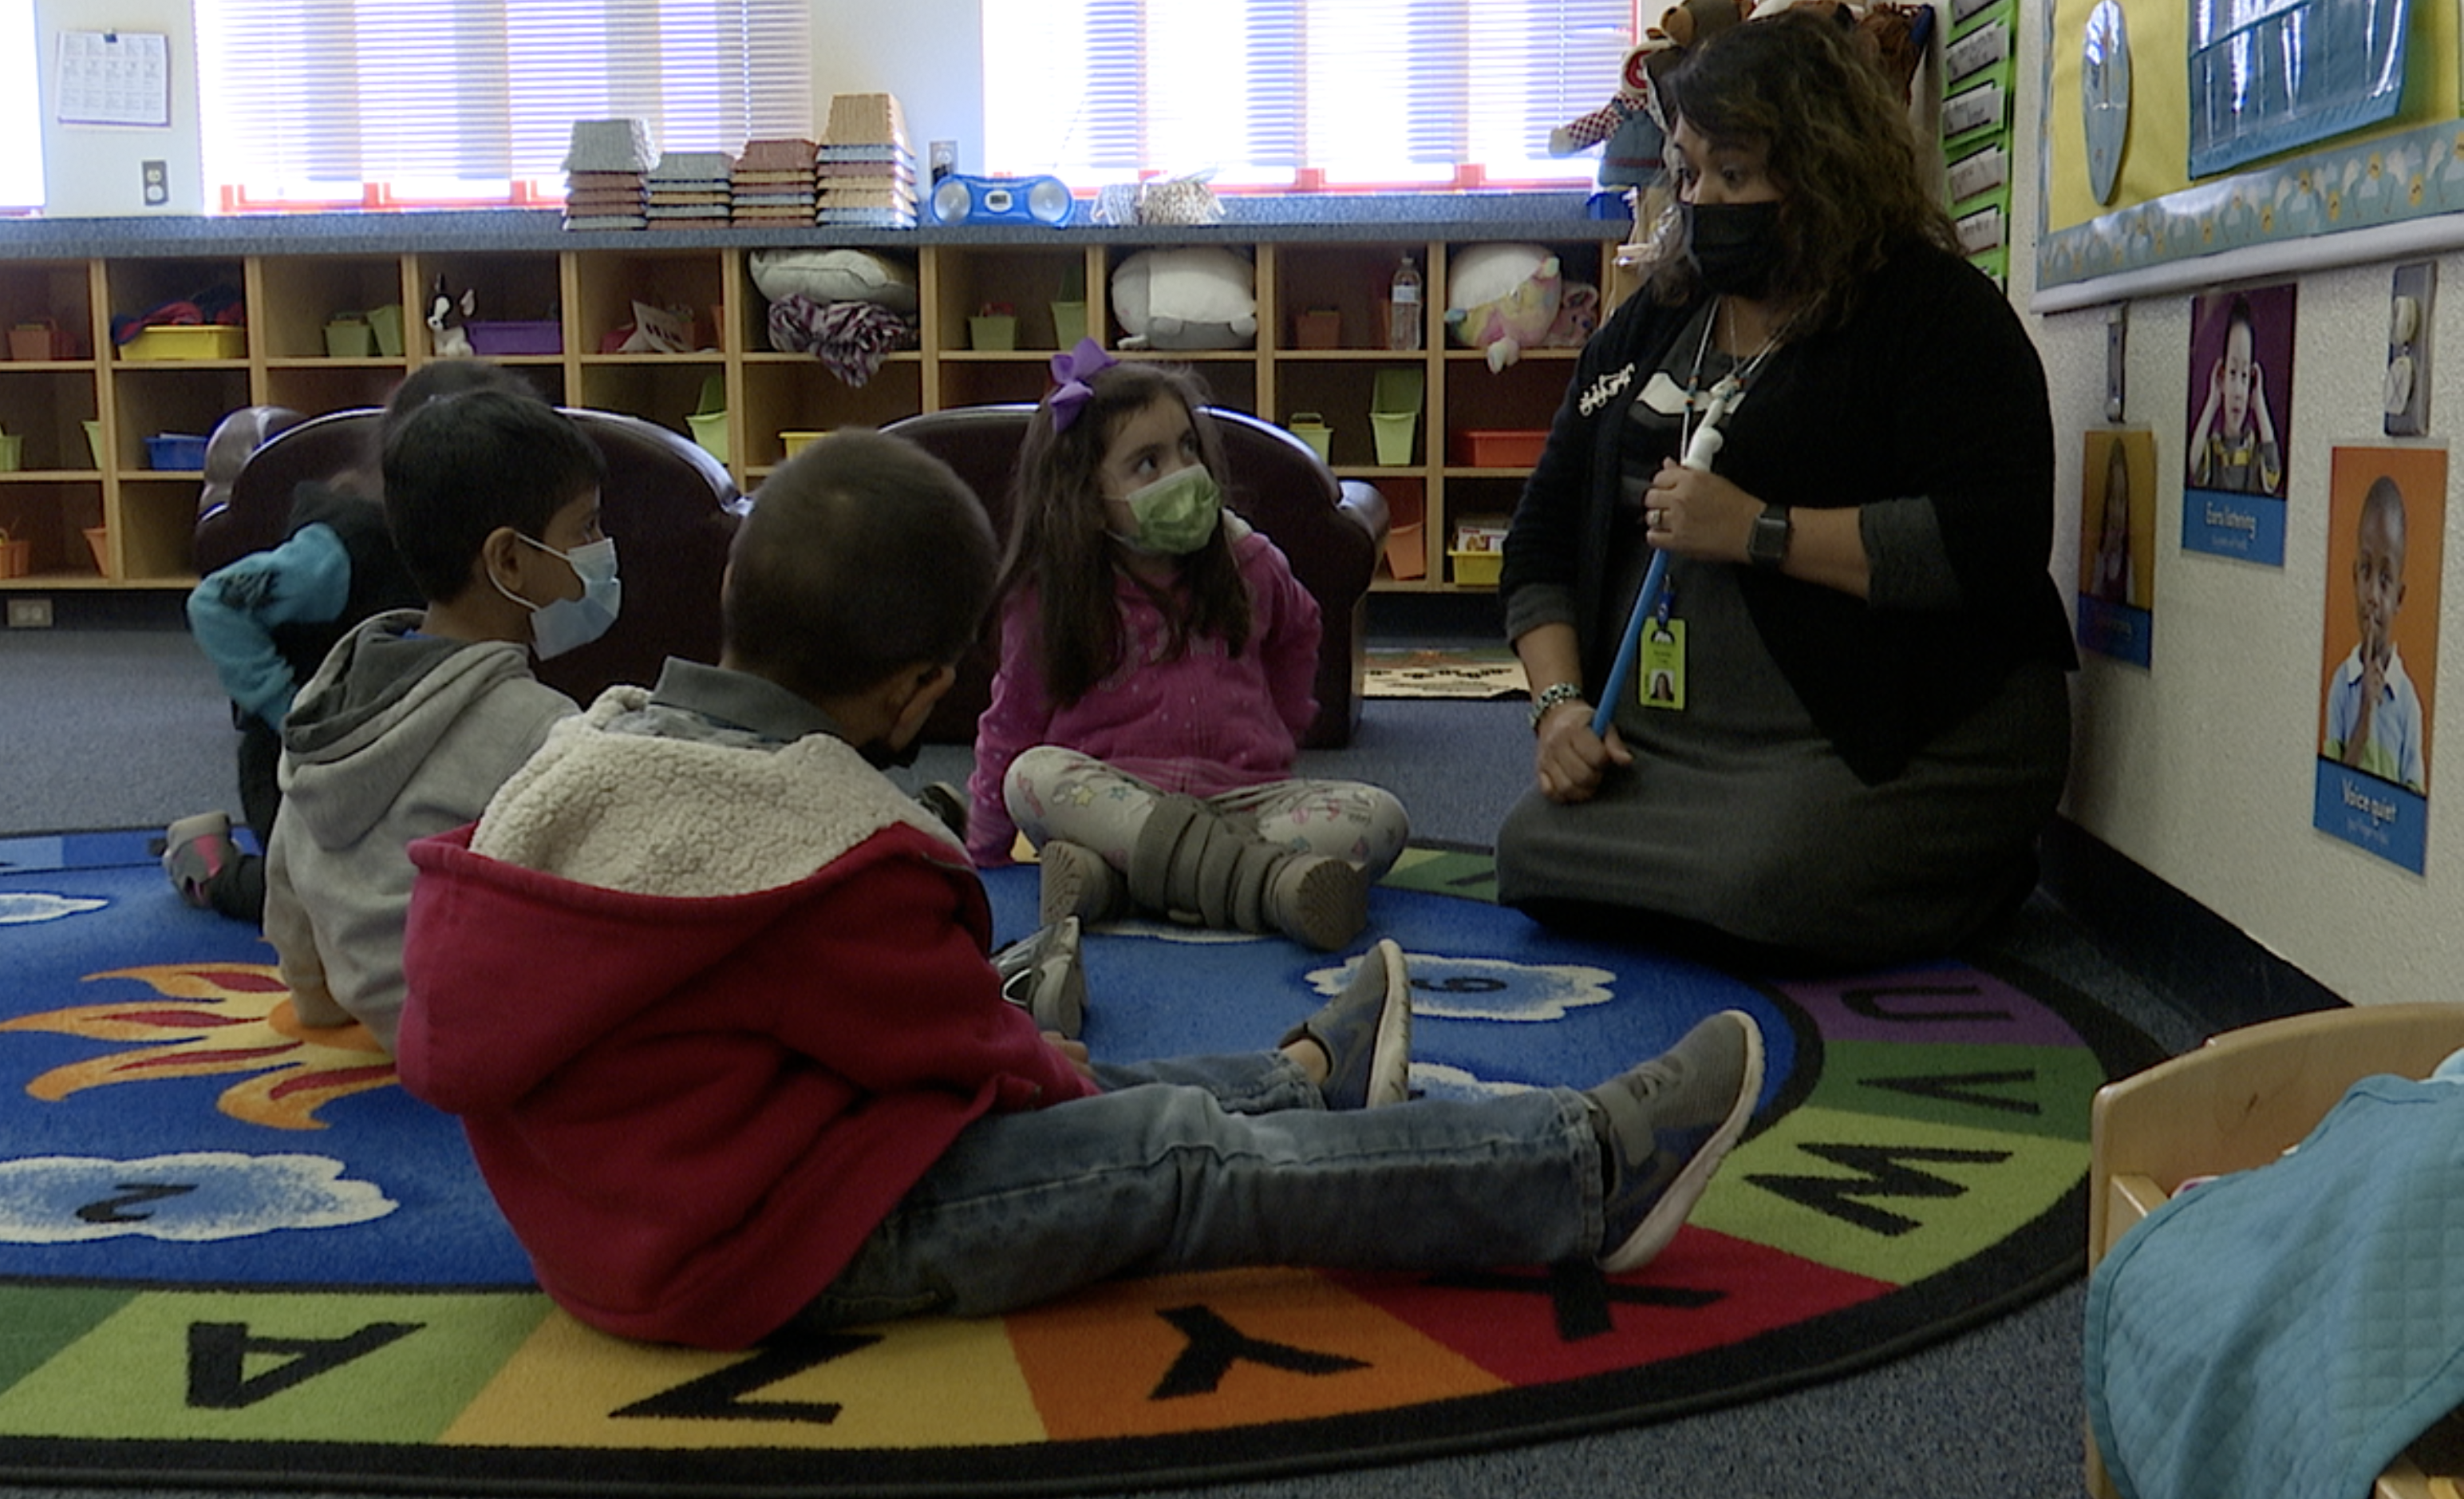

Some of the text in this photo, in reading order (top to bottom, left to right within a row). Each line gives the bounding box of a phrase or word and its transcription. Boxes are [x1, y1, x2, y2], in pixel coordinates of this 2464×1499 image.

[2342, 777, 2396, 828] Voice quiet
[1838, 985, 2016, 1022] U
[1856, 1068, 2042, 1116] V
[75, 1184, 200, 1224] 2
[185, 1321, 428, 1409] A
[1147, 1303, 1374, 1402] Y
